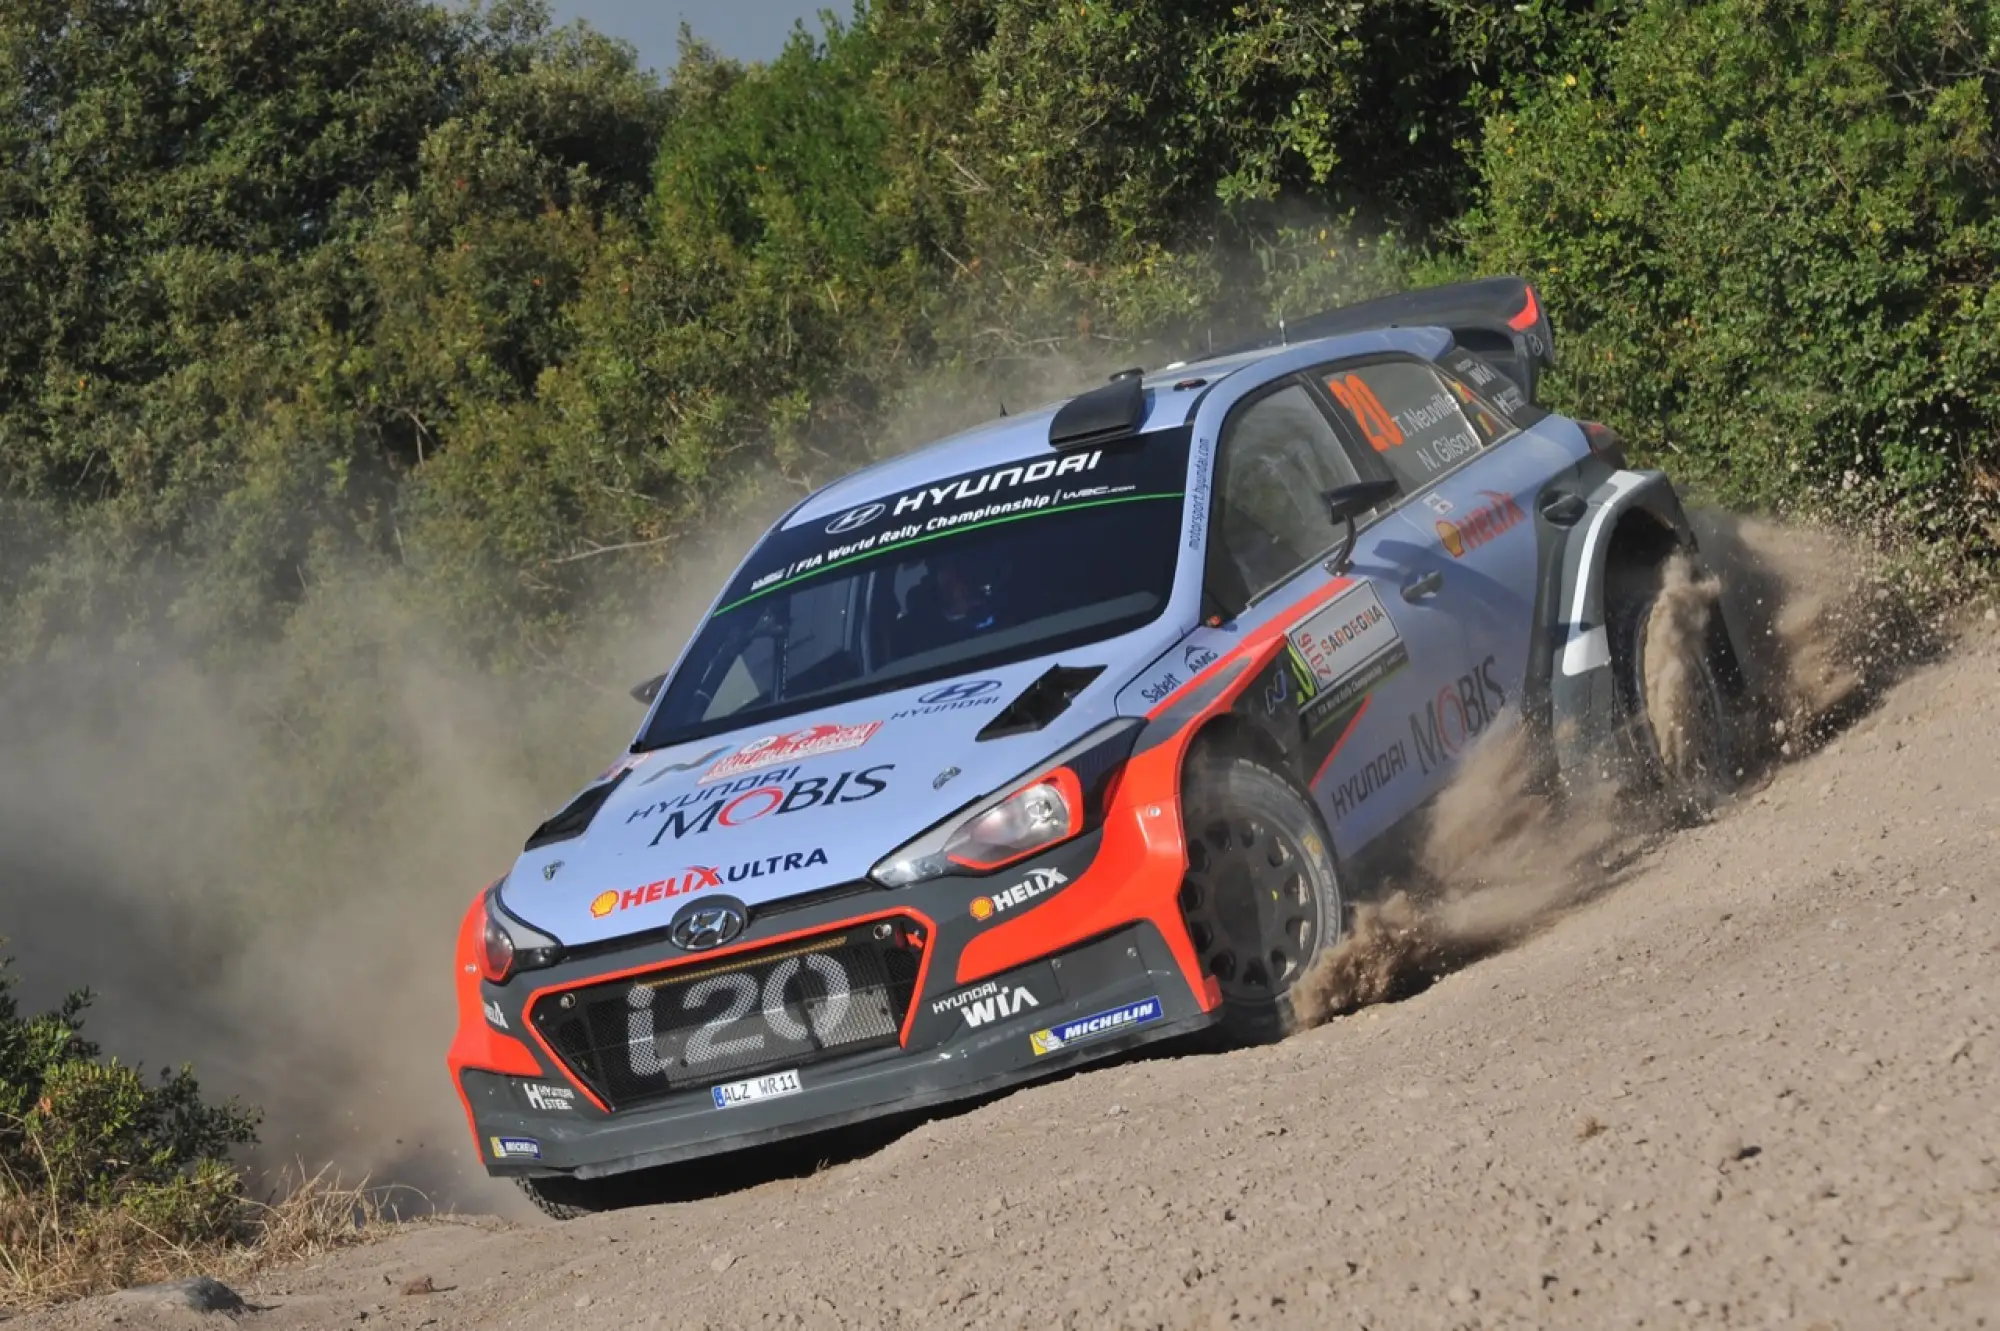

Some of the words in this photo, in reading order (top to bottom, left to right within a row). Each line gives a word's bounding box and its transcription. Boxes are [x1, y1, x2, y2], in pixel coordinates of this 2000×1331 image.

[1328, 373, 1404, 453] 20
[893, 450, 1102, 517] HYUNDAI
[796, 553, 823, 573] FIA
[827, 535, 876, 562] World
[878, 522, 924, 545] Rally
[926, 494, 1050, 533] Championship
[1298, 632, 1332, 681] 2016
[1320, 604, 1385, 655] SARDEGNA
[891, 696, 1000, 721] HYUNDAI
[1331, 738, 1407, 821] HYUNDAI
[1409, 654, 1506, 776] MOBIS
[625, 765, 802, 825] HYUNDAI
[648, 763, 895, 848] MOBIS
[620, 865, 724, 910] HELIX
[727, 847, 829, 883] ULTRA
[992, 867, 1068, 912] HELIX
[627, 953, 850, 1077] i20
[932, 981, 998, 1014] HYUNDAI
[961, 986, 1039, 1028] WIA
[1064, 1002, 1153, 1040] MICHELIN
[725, 1083, 750, 1101] ALZ
